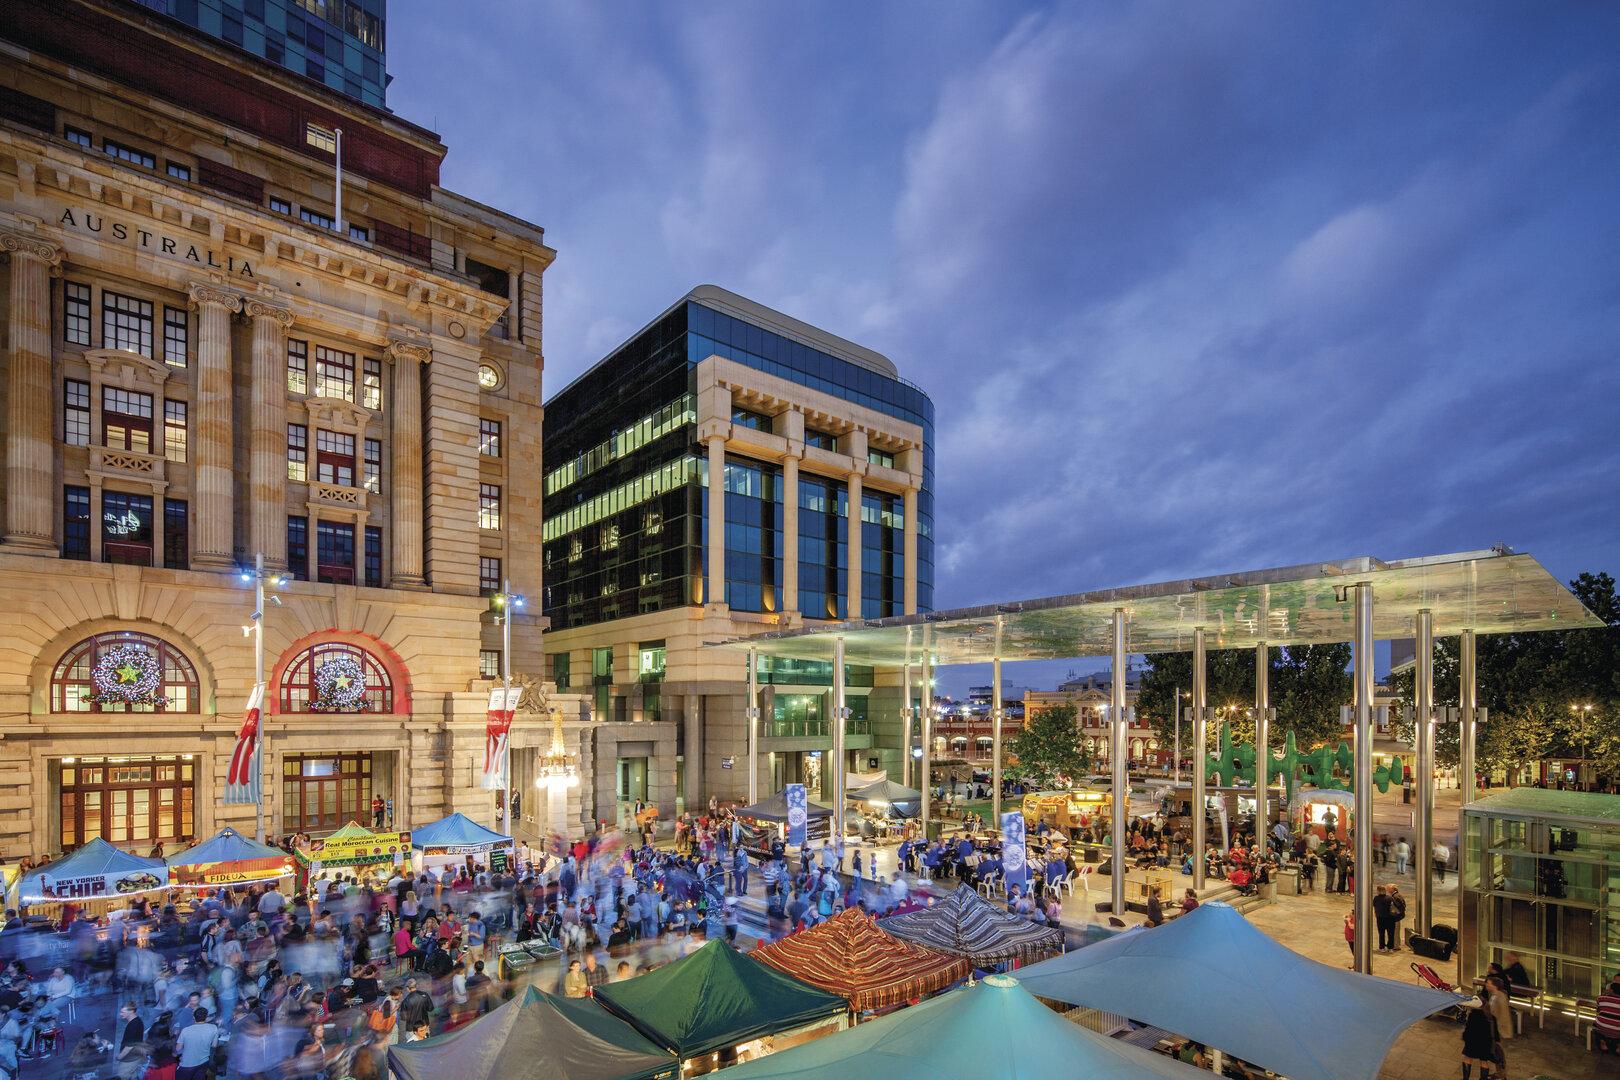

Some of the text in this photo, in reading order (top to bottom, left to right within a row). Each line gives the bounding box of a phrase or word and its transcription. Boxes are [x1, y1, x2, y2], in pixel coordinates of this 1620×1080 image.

[60, 208, 255, 278] AUSTRALIA
[56, 875, 106, 887] NEW YORKER
[210, 873, 247, 883] FIDEUA
[56, 882, 106, 899] CHIP
